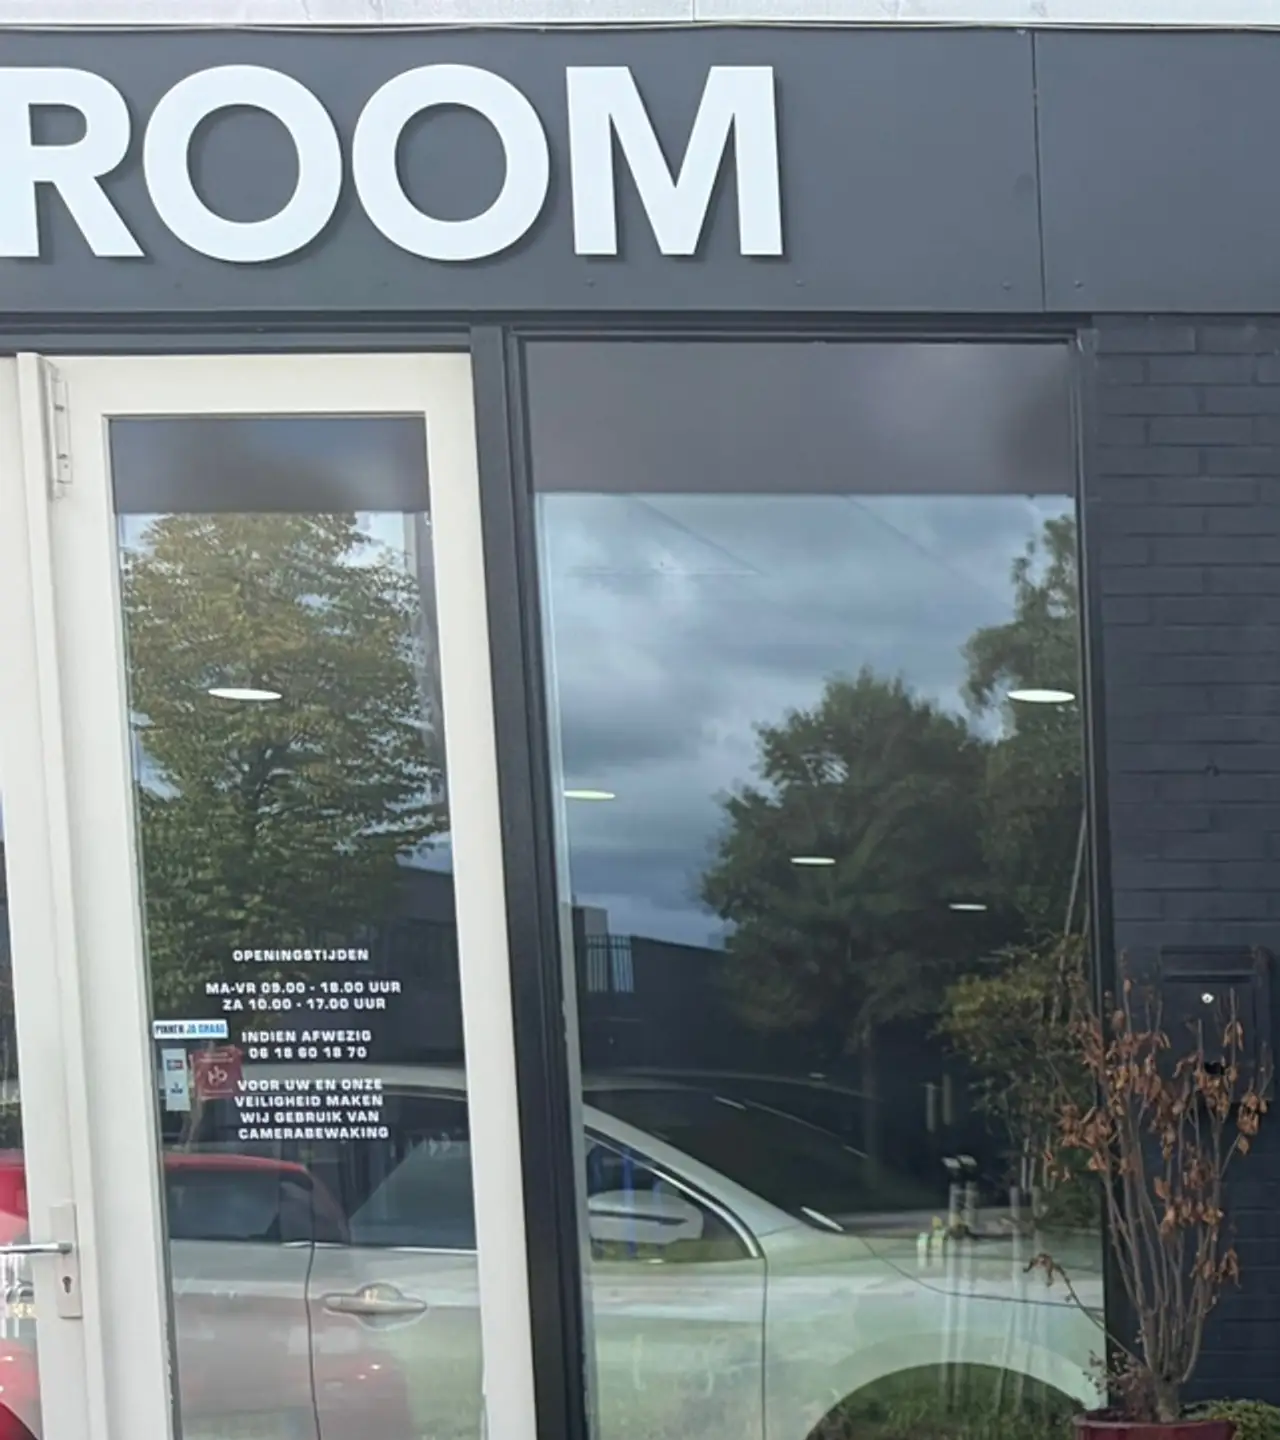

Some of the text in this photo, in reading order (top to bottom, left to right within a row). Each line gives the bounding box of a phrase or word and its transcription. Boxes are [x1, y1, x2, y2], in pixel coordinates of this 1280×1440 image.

[0, 64, 784, 263] ROOM
[232, 949, 369, 962] OPENINGSTIJDEN
[205, 982, 256, 994] MA-VR
[260, 981, 305, 994] 09.00
[368, 981, 401, 993] UUR
[222, 999, 244, 1011] ZA
[249, 998, 292, 1010] 10.00
[306, 998, 349, 1010] 17.00
[353, 998, 386, 1009] UUR
[241, 1030, 372, 1043] INDIEN AFWEZIG
[346, 1046, 367, 1058] 70
[237, 1078, 383, 1091] VOOR UW EN ONZE
[234, 1095, 383, 1107] VEILIGHEID MAKEN
[240, 1111, 379, 1123] WIJ GEBRUIK VAN
[238, 1126, 390, 1140] CAMERABEWAKING
